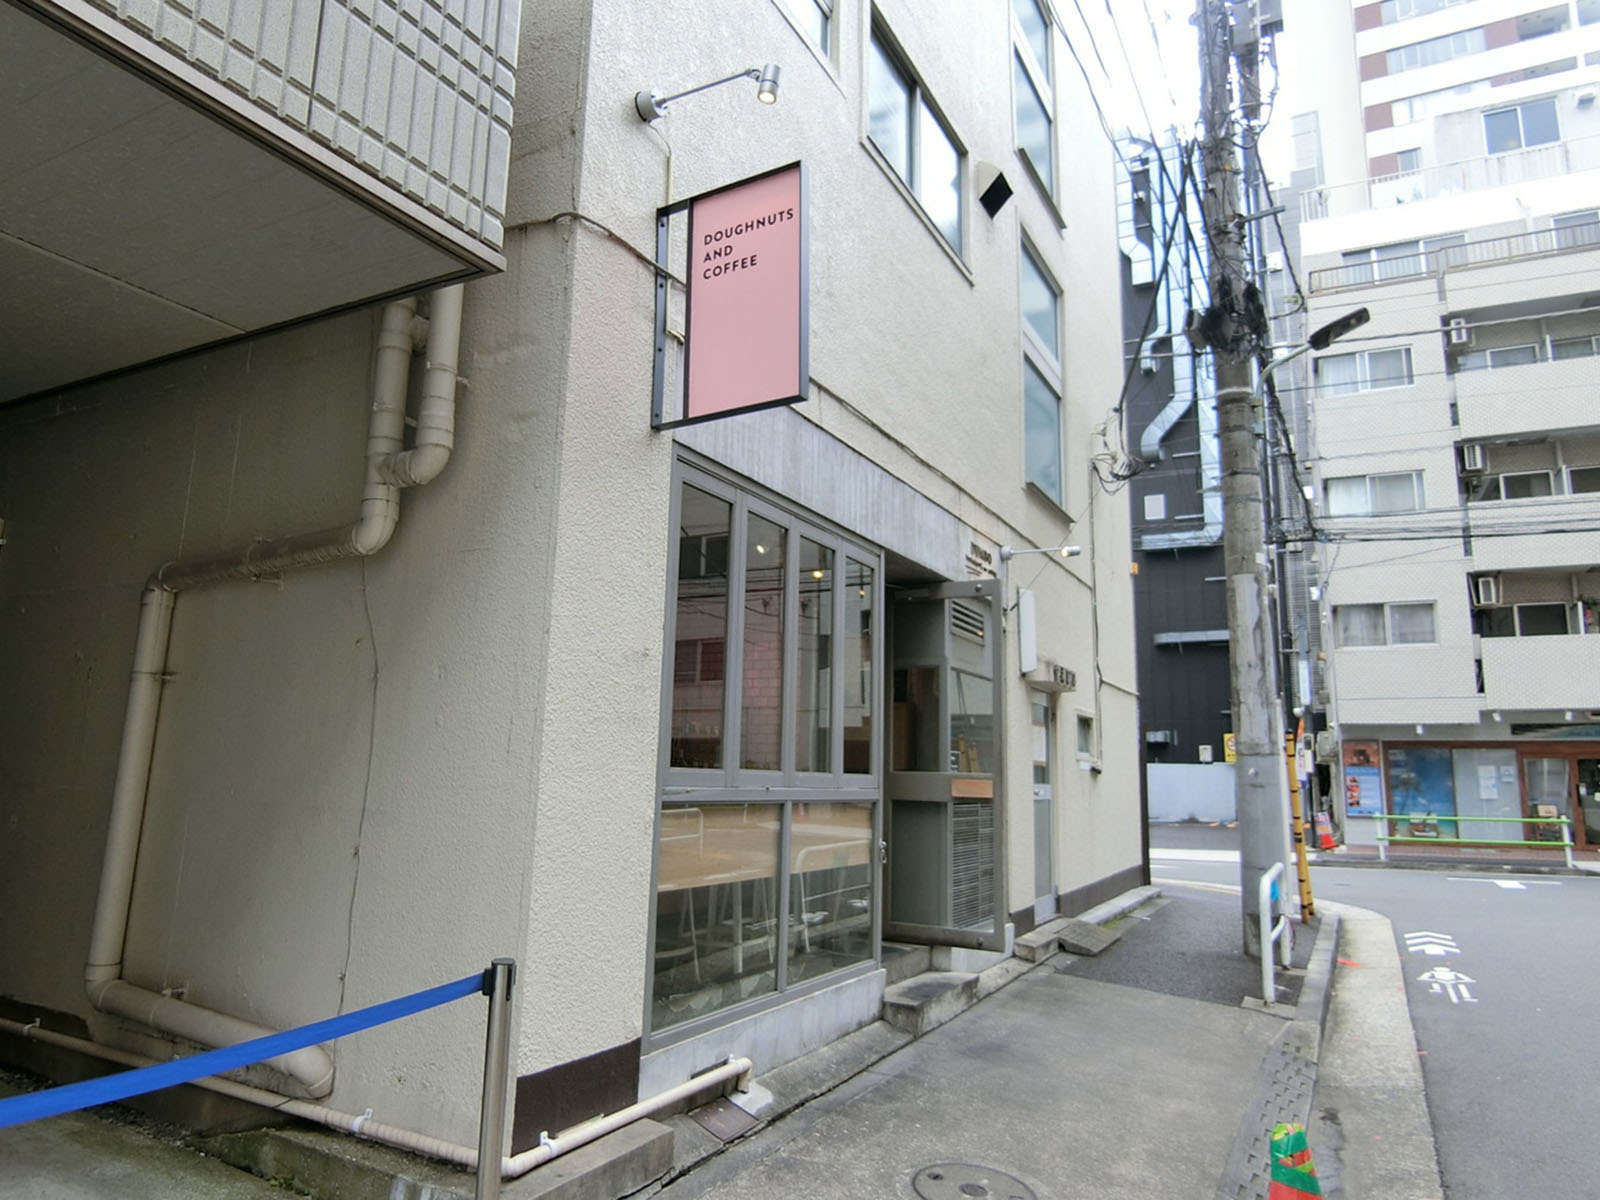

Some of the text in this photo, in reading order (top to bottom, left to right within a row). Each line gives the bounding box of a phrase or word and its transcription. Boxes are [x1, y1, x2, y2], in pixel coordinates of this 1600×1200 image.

[704, 208, 794, 245] DOUGHNUTS
[703, 245, 733, 263] AND
[703, 254, 757, 280] COFFEE
